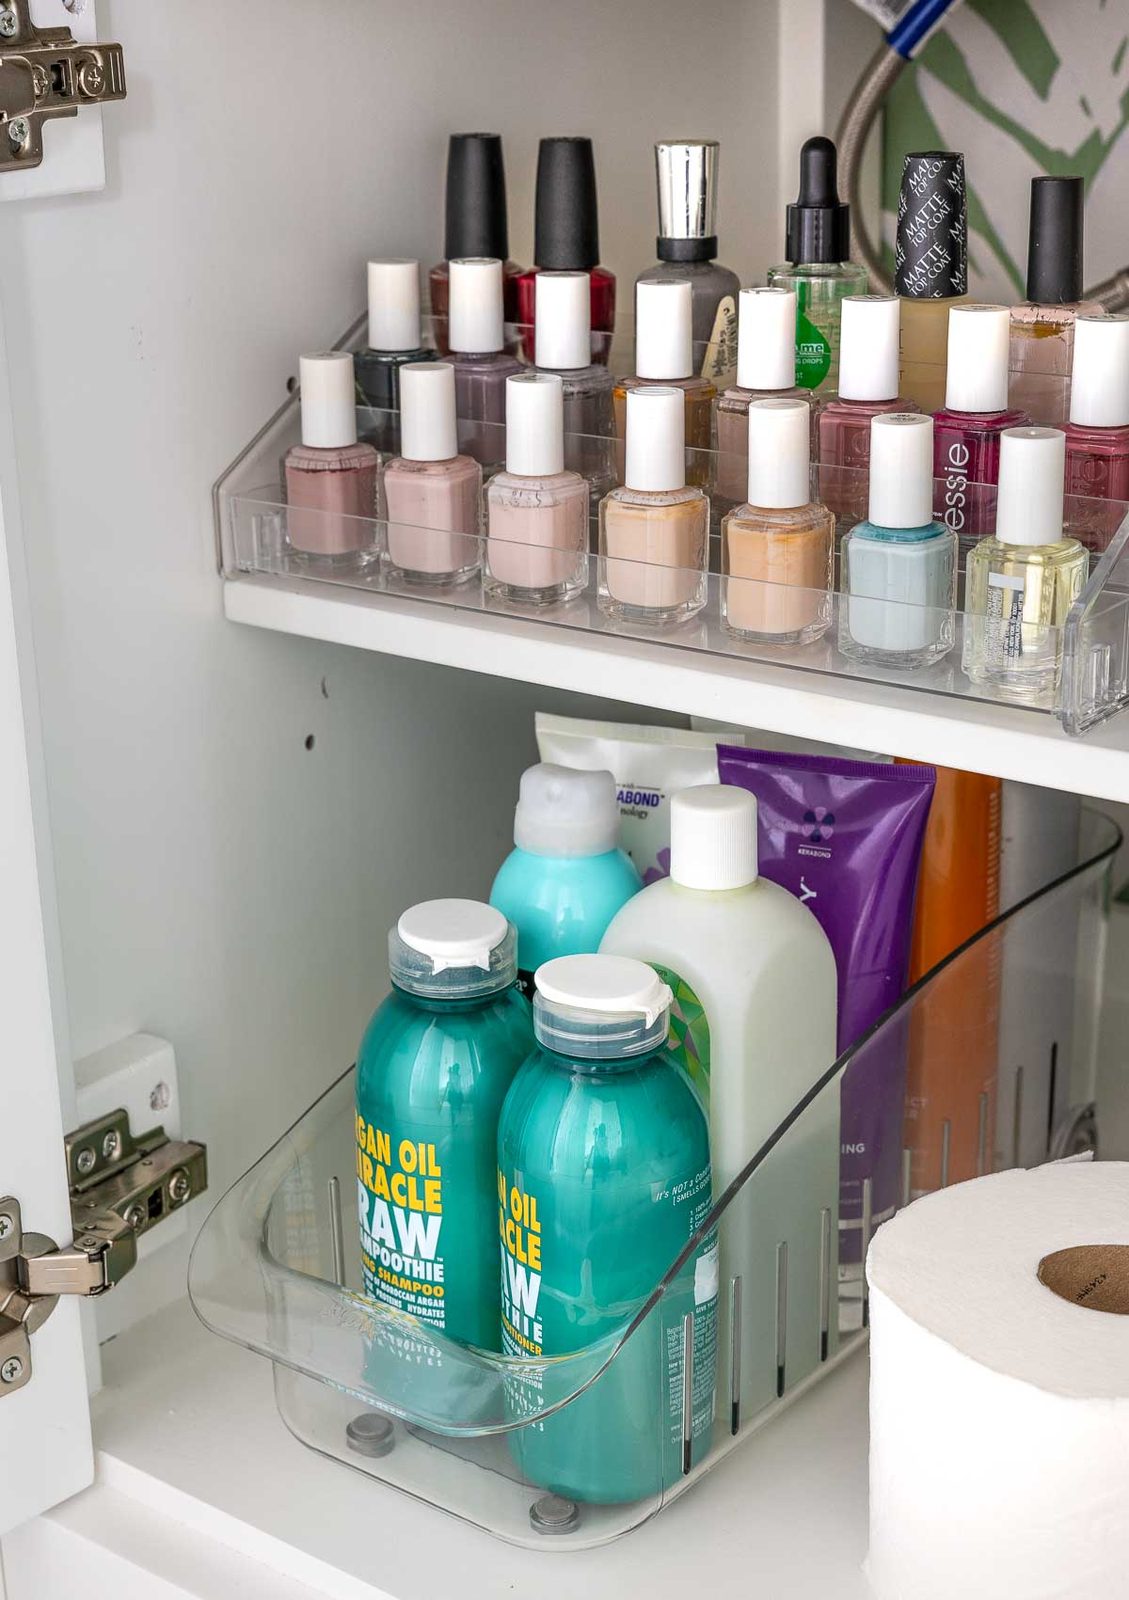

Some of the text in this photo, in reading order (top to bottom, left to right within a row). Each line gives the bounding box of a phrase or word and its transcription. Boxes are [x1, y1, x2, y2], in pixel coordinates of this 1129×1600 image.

[912, 177, 928, 197] TOP
[905, 191, 946, 240] MATTE
[911, 201, 951, 248] TOP COAT
[903, 241, 946, 289] MATTE
[909, 276, 928, 296] TOP
[927, 251, 952, 279] COAT
[944, 443, 970, 531] essie
[616, 790, 660, 807] ABOND
[398, 1139, 442, 1178] OIL
[671, 1180, 688, 1196] NOT
[511, 1187, 541, 1234] OIL
[377, 1266, 444, 1297] SHAMPOO
[407, 1303, 445, 1318] HYDRATES
[417, 1296, 445, 1308] ARGAN
